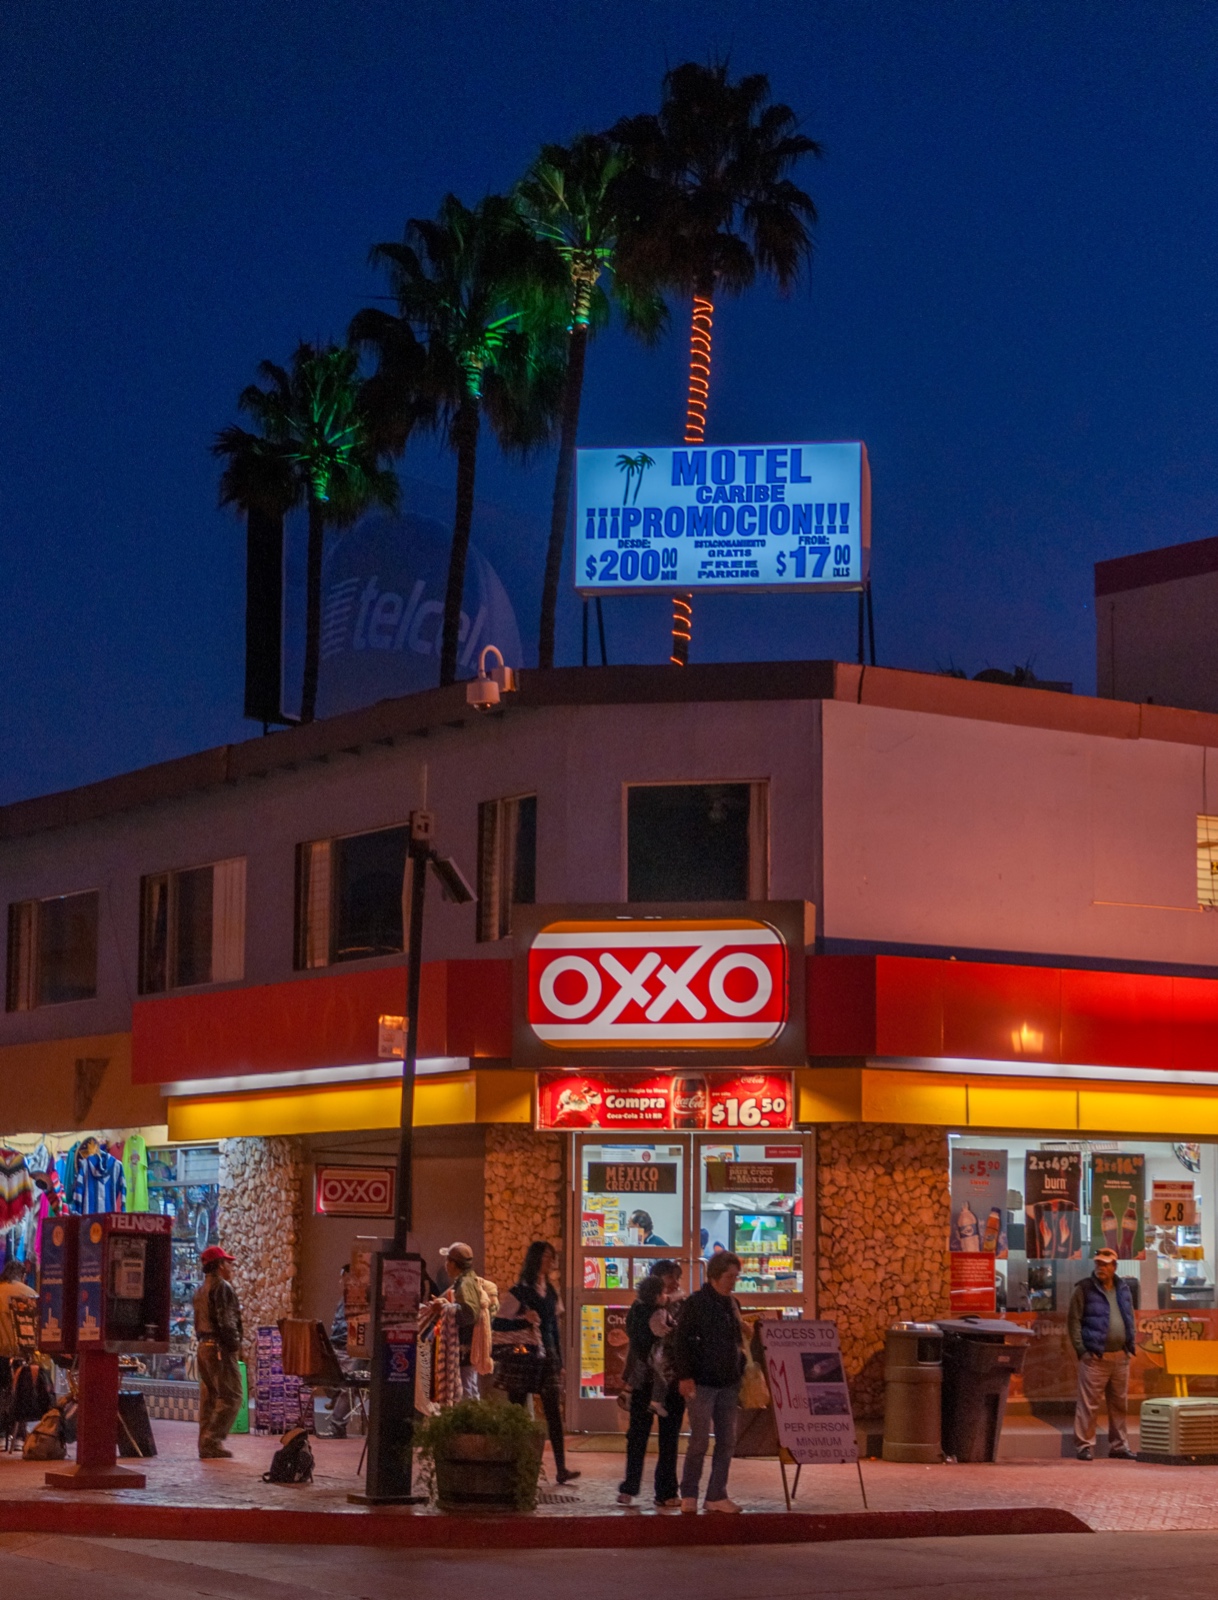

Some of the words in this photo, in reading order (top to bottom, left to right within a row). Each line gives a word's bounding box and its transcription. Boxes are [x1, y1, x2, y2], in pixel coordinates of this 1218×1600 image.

[671, 448, 812, 486] MOTEL
[696, 484, 785, 504] CARIBE
[618, 539, 651, 549] DESDE:
[694, 539, 766, 549] ESTACIONAMIENTO
[798, 535, 830, 545] FROM:
[708, 549, 752, 558] GRATIS
[700, 560, 758, 569] FREE
[697, 570, 760, 579] PARKING
[539, 946, 773, 1024] OXXO
[605, 1094, 666, 1112] Compra
[606, 1112, 638, 1120] Coca-Cola
[605, 1164, 659, 1182] MÉXICO
[729, 1169, 749, 1178] para
[605, 1181, 631, 1191] CREO
[632, 1181, 646, 1191] EN
[648, 1181, 658, 1192] TI
[1044, 1174, 1067, 1190] burn
[324, 1180, 386, 1202] OXXO
[1164, 1202, 1184, 1222] 2.8
[110, 1213, 166, 1232] TELNOR
[1138, 1317, 1188, 1334] Comida
[766, 1328, 815, 1339] ACCESS
[817, 1328, 835, 1339] TO
[769, 1356, 792, 1414] $1
[784, 1422, 806, 1432] PER
[807, 1422, 850, 1432] PERSON
[796, 1437, 842, 1447] MINIMUM
[791, 1449, 806, 1458] RIP
[808, 1449, 831, 1459] $4.00
[833, 1448, 857, 1458] DLLS
